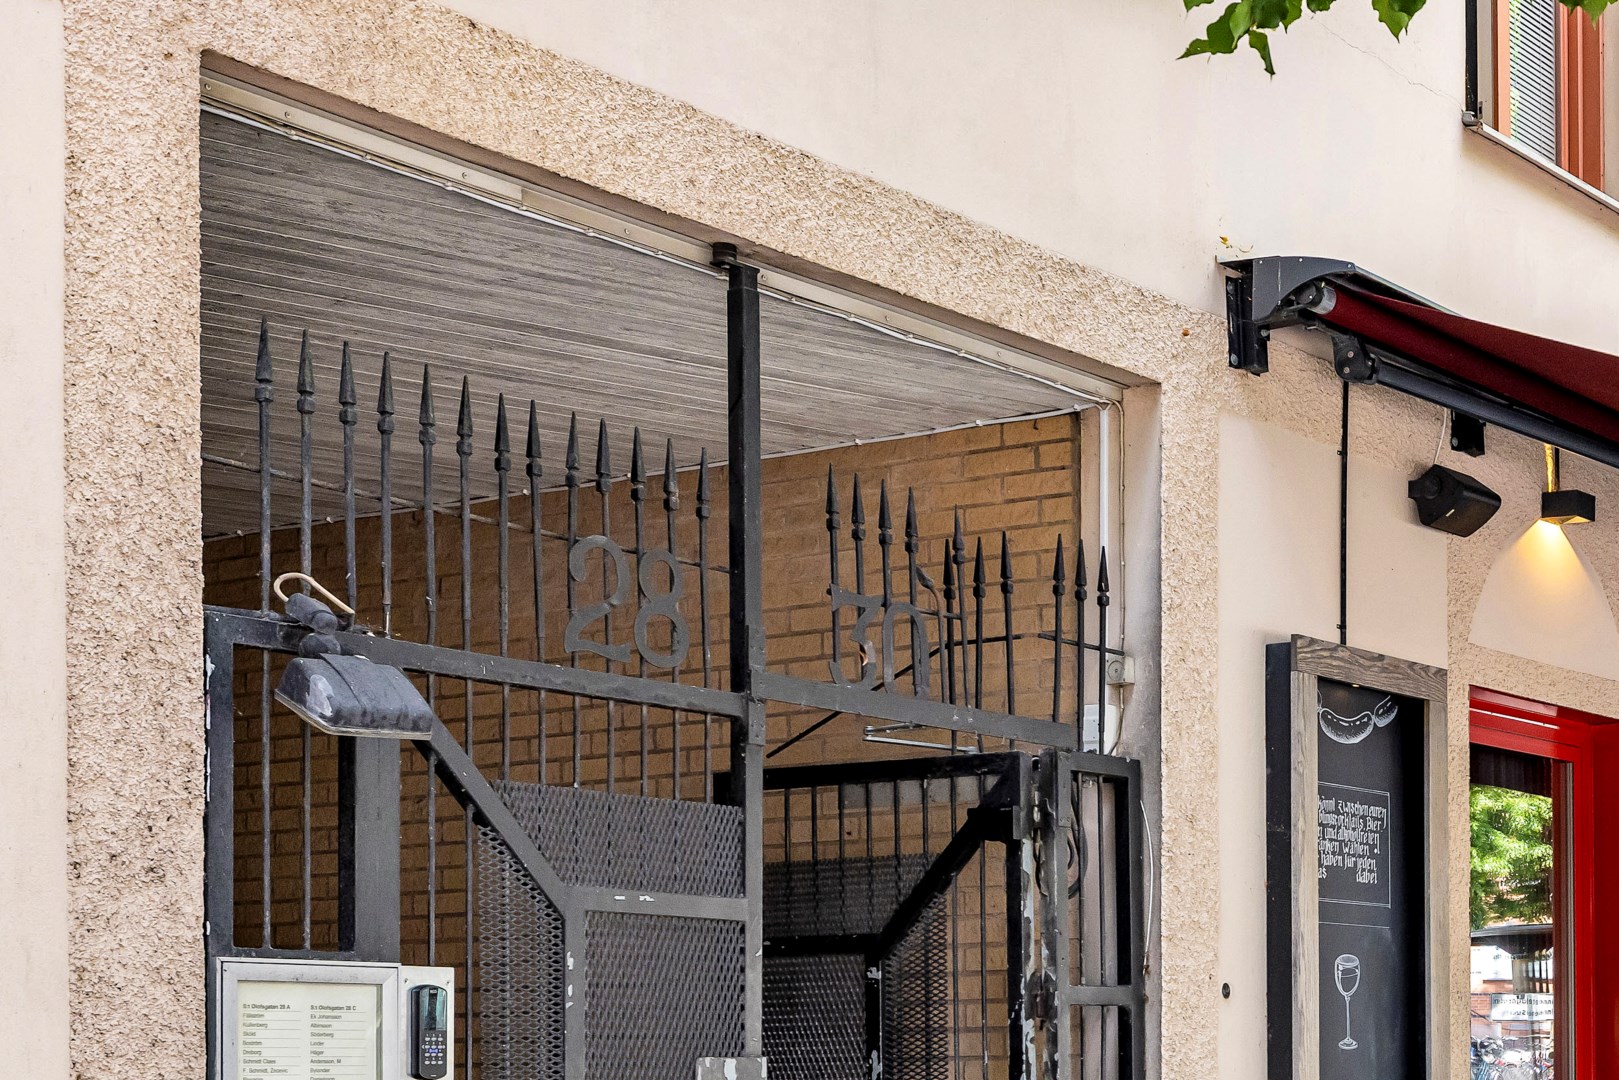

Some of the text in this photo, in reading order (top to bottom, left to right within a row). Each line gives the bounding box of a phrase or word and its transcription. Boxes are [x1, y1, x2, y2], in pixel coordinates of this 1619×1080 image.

[564, 534, 690, 668] 28
[829, 582, 931, 699] 30
[1356, 869, 1377, 884] dabei
